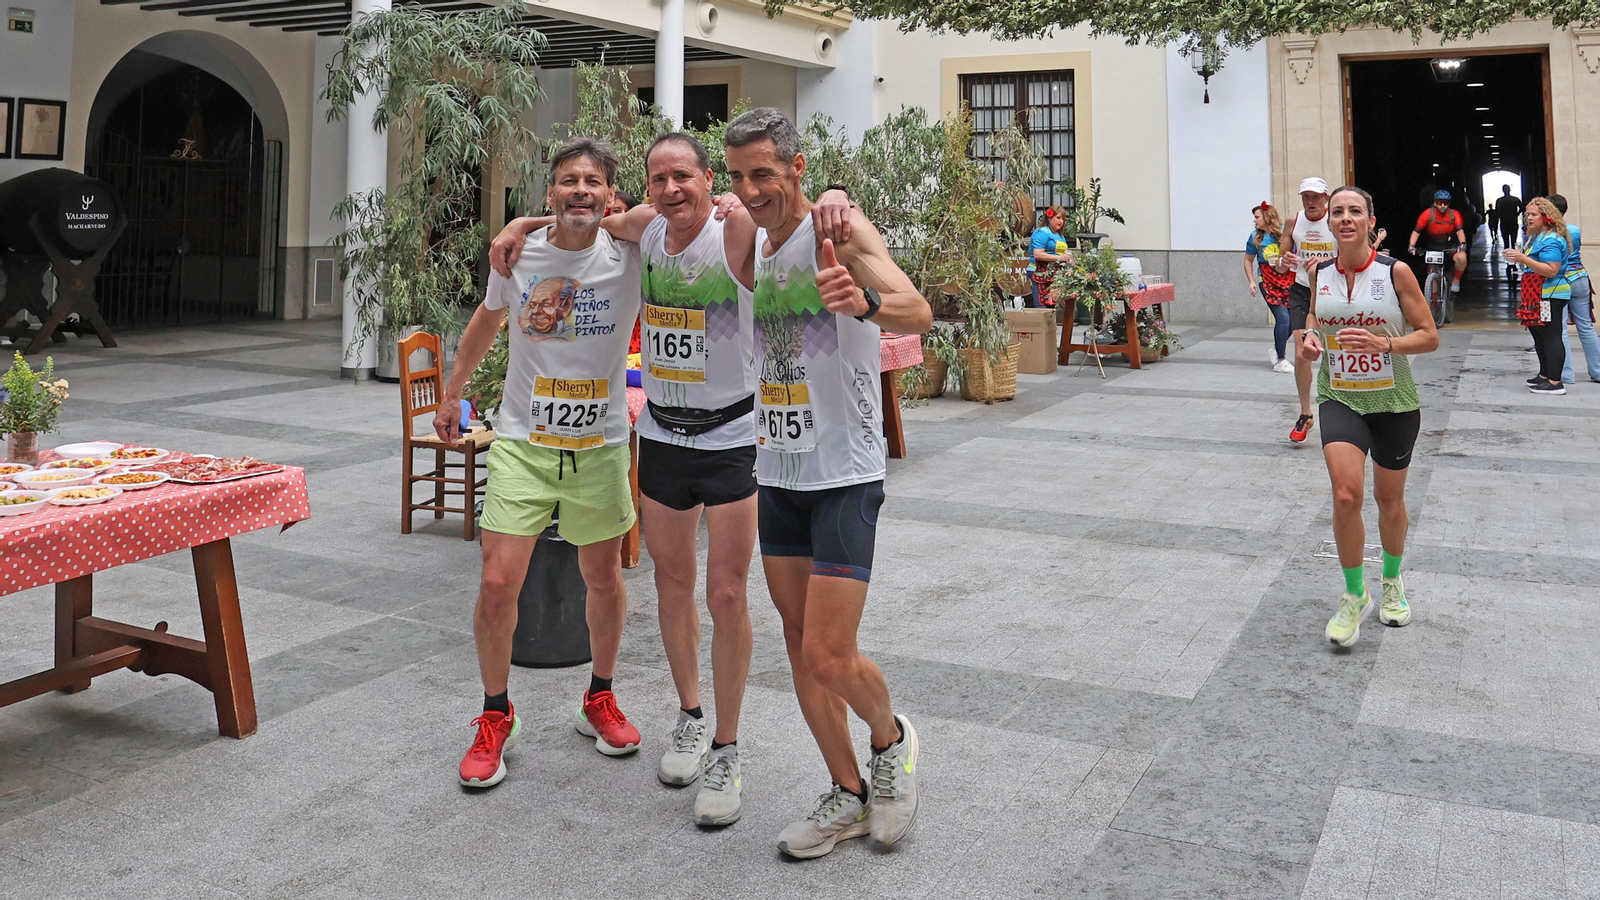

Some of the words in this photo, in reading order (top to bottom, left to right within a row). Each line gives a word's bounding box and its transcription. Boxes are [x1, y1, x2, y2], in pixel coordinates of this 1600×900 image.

[65, 212, 109, 220] VALDESPINO
[573, 288, 594, 299] LOS
[573, 299, 610, 313] NIÑOS
[575, 314, 600, 326] DEL
[649, 306, 684, 323] Sherry
[1317, 311, 1388, 326] maratón
[575, 323, 616, 337] PINTOR
[1337, 353, 1382, 373] 1265
[556, 380, 591, 394] Sherry
[852, 367, 872, 394] Los
[760, 384, 785, 400] Sherry
[543, 402, 599, 428] 1225
